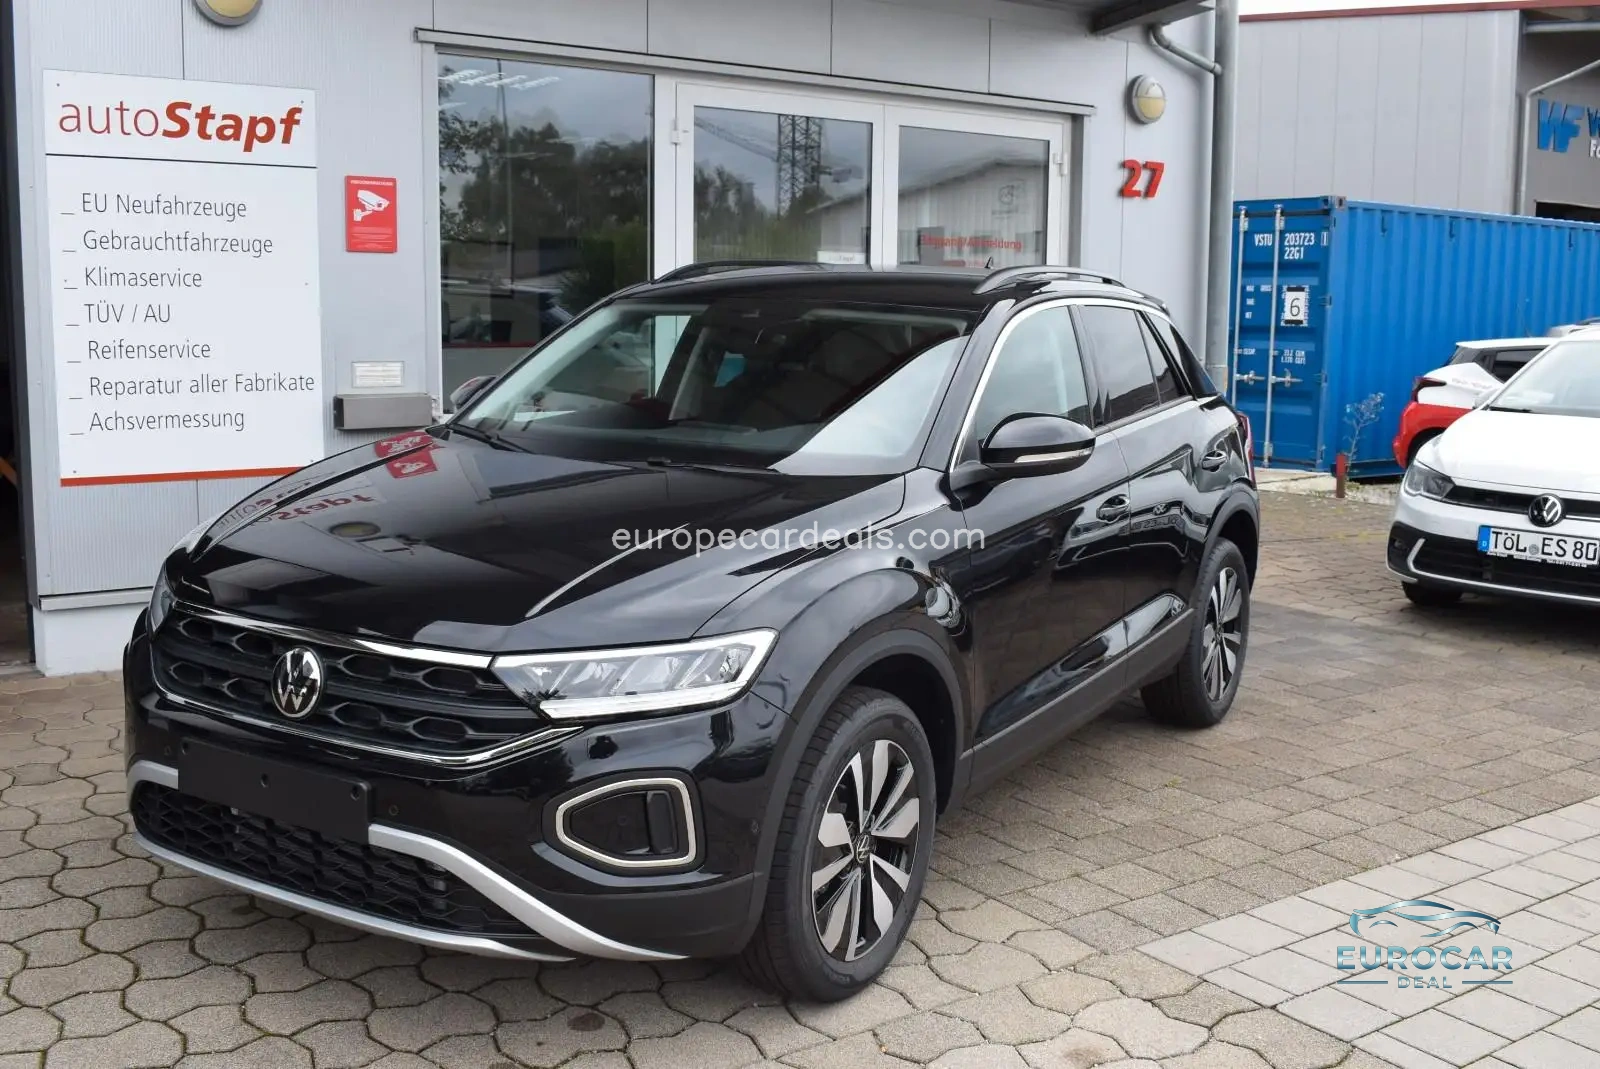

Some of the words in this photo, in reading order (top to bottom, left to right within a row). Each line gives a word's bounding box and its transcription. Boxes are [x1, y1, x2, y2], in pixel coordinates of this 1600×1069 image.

[58, 100, 303, 152] autoStapf
[1117, 159, 1165, 198] 27
[82, 192, 108, 213] EU
[116, 194, 247, 223] Neufahrzeuge
[83, 229, 273, 258] Gebrauchtfahrzeuge
[1254, 233, 1273, 246] VSTU
[1284, 232, 1315, 246] 203723
[1284, 247, 1304, 260] 22G1
[85, 266, 202, 288] Klimaservice
[84, 300, 125, 323] TÜV
[144, 303, 171, 323] AU
[1290, 297, 1301, 317] 6
[88, 338, 211, 360] Reifenservice
[90, 376, 183, 400] Reparatur
[189, 374, 228, 394] aller
[235, 372, 315, 393] Fabrikate
[89, 410, 245, 432] Achsvermessung
[1491, 530, 1527, 553] TÖL
[1541, 536, 1568, 558] ES
[1572, 540, 1598, 561] 80
